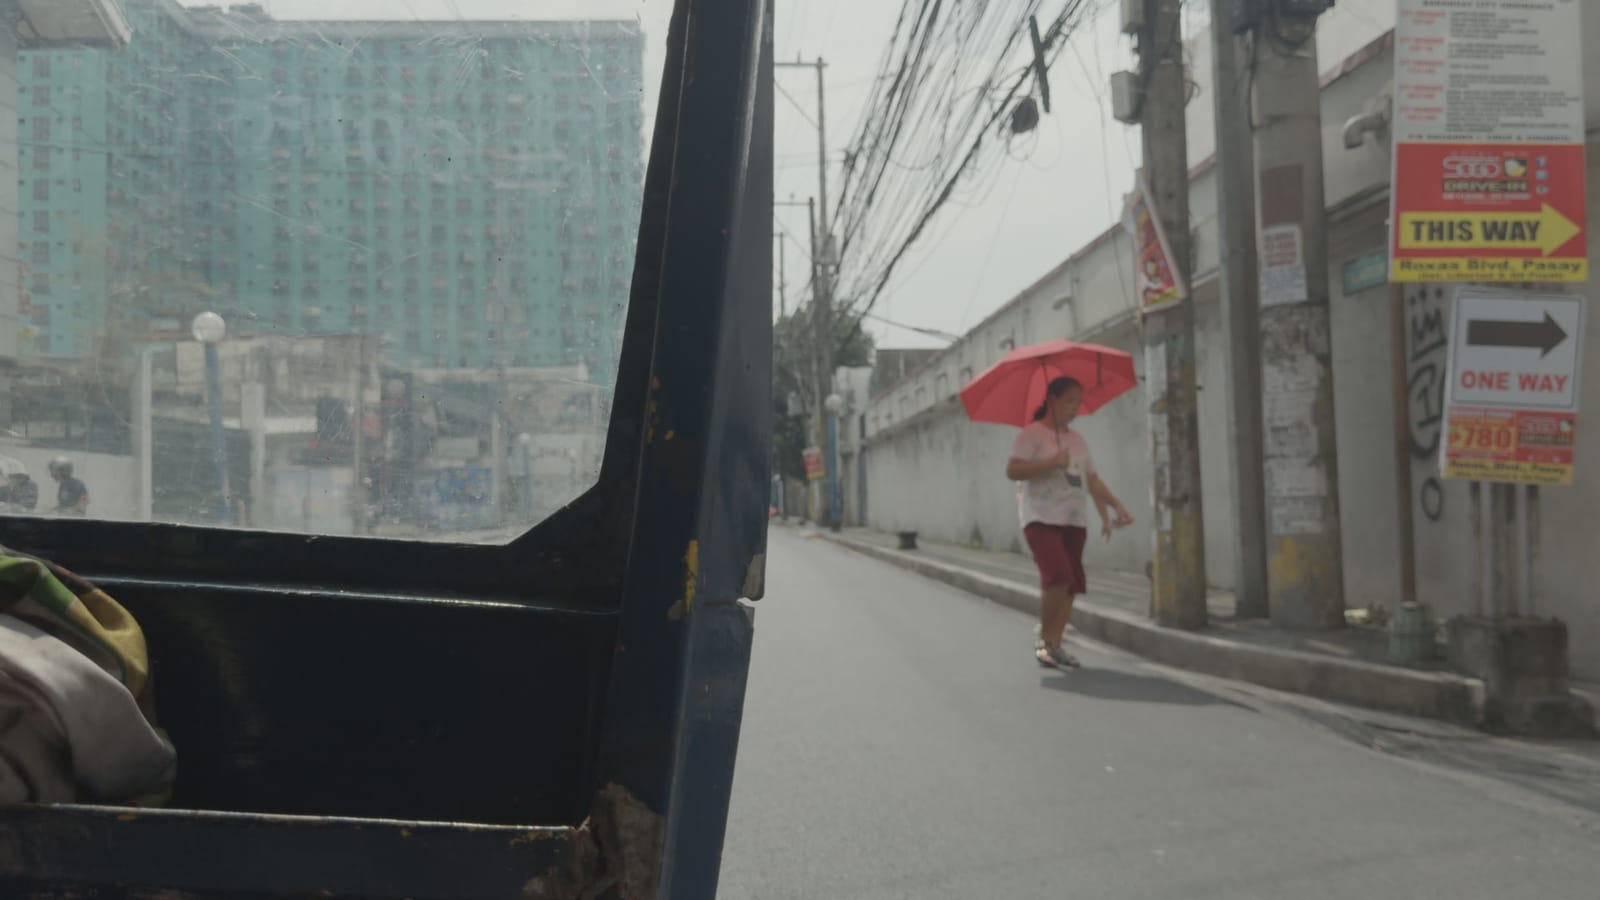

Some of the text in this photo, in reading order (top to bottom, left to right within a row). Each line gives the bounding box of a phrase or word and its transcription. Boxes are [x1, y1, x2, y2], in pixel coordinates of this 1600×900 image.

[1443, 181, 1528, 192] DRIVE-IN
[1411, 221, 1540, 241] THIS WAY
[1400, 260, 1459, 271] Roxas
[1522, 260, 1581, 272] Pasay
[1461, 371, 1568, 392] ONE WAY
